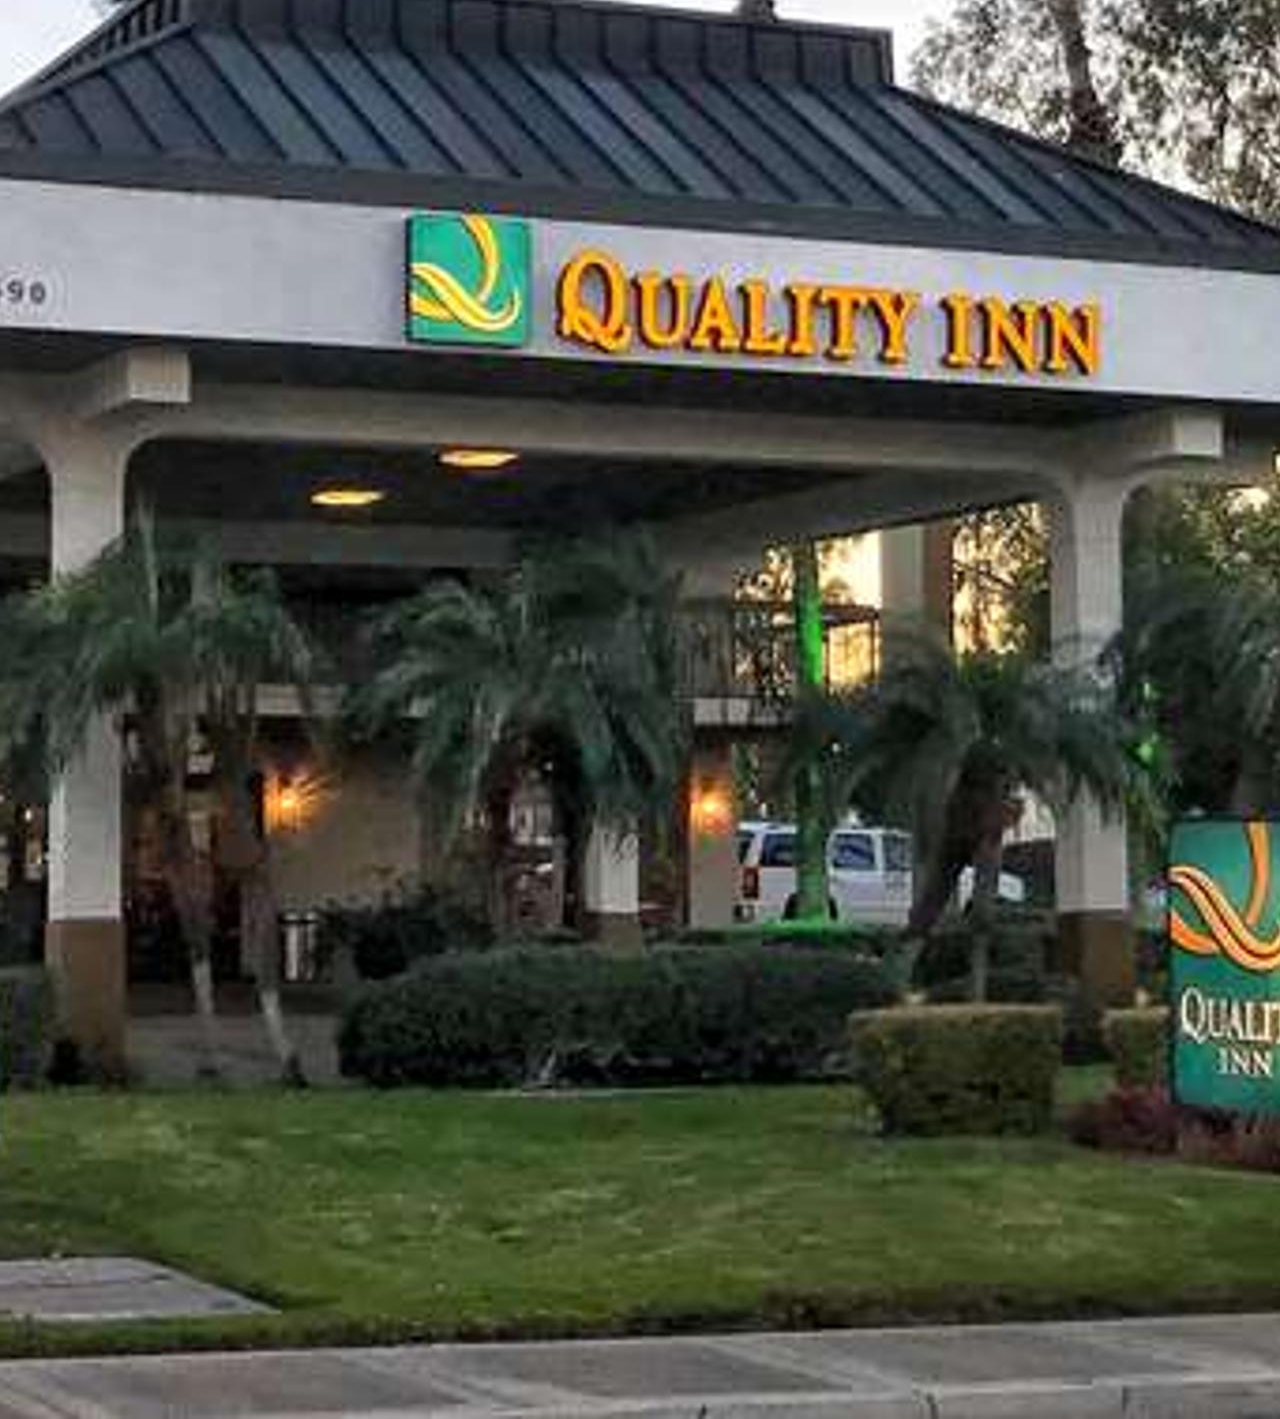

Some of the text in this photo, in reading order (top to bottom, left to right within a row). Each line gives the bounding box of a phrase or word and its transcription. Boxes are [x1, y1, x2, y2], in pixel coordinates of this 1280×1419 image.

[556, 249, 1101, 375] QUALITY INN
[1218, 1049, 1273, 1077] INN
